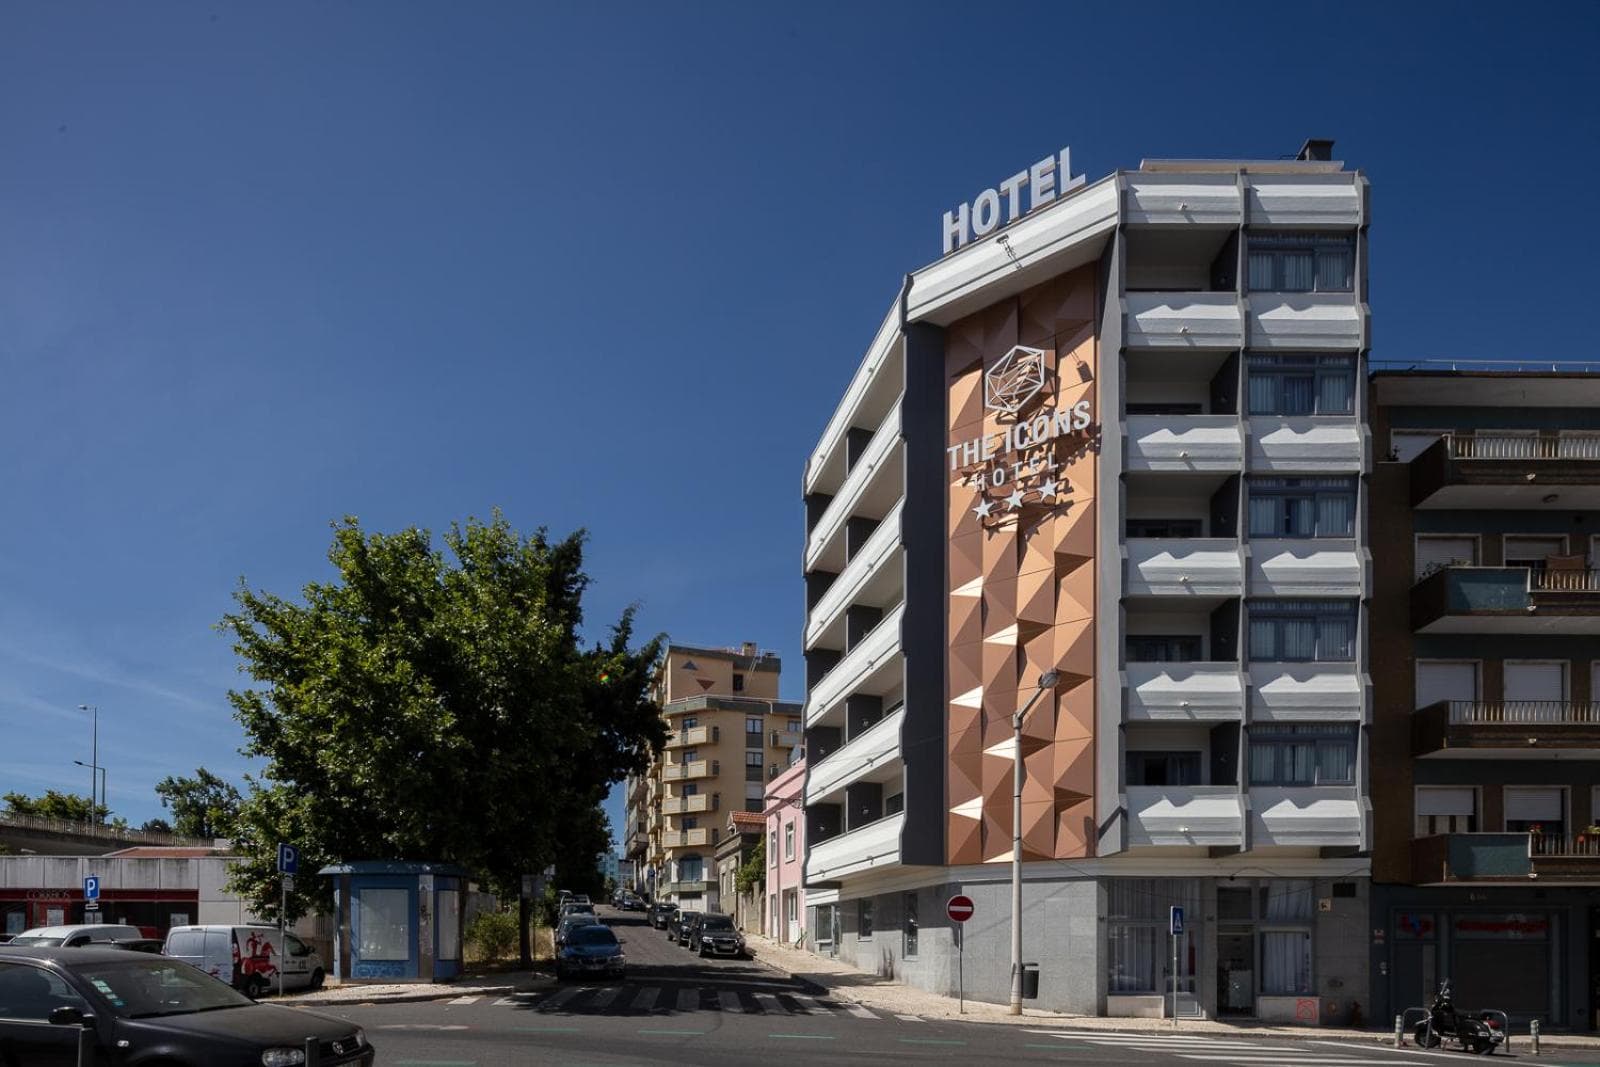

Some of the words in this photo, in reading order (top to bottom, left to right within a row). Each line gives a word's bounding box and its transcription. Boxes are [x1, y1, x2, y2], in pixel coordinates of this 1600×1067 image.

[943, 145, 1085, 254] HOTEL
[947, 432, 995, 471] THE
[1006, 400, 1091, 453] ICONS
[974, 452, 1059, 493] HOTEL
[283, 847, 295, 870] P
[87, 879, 96, 897] P
